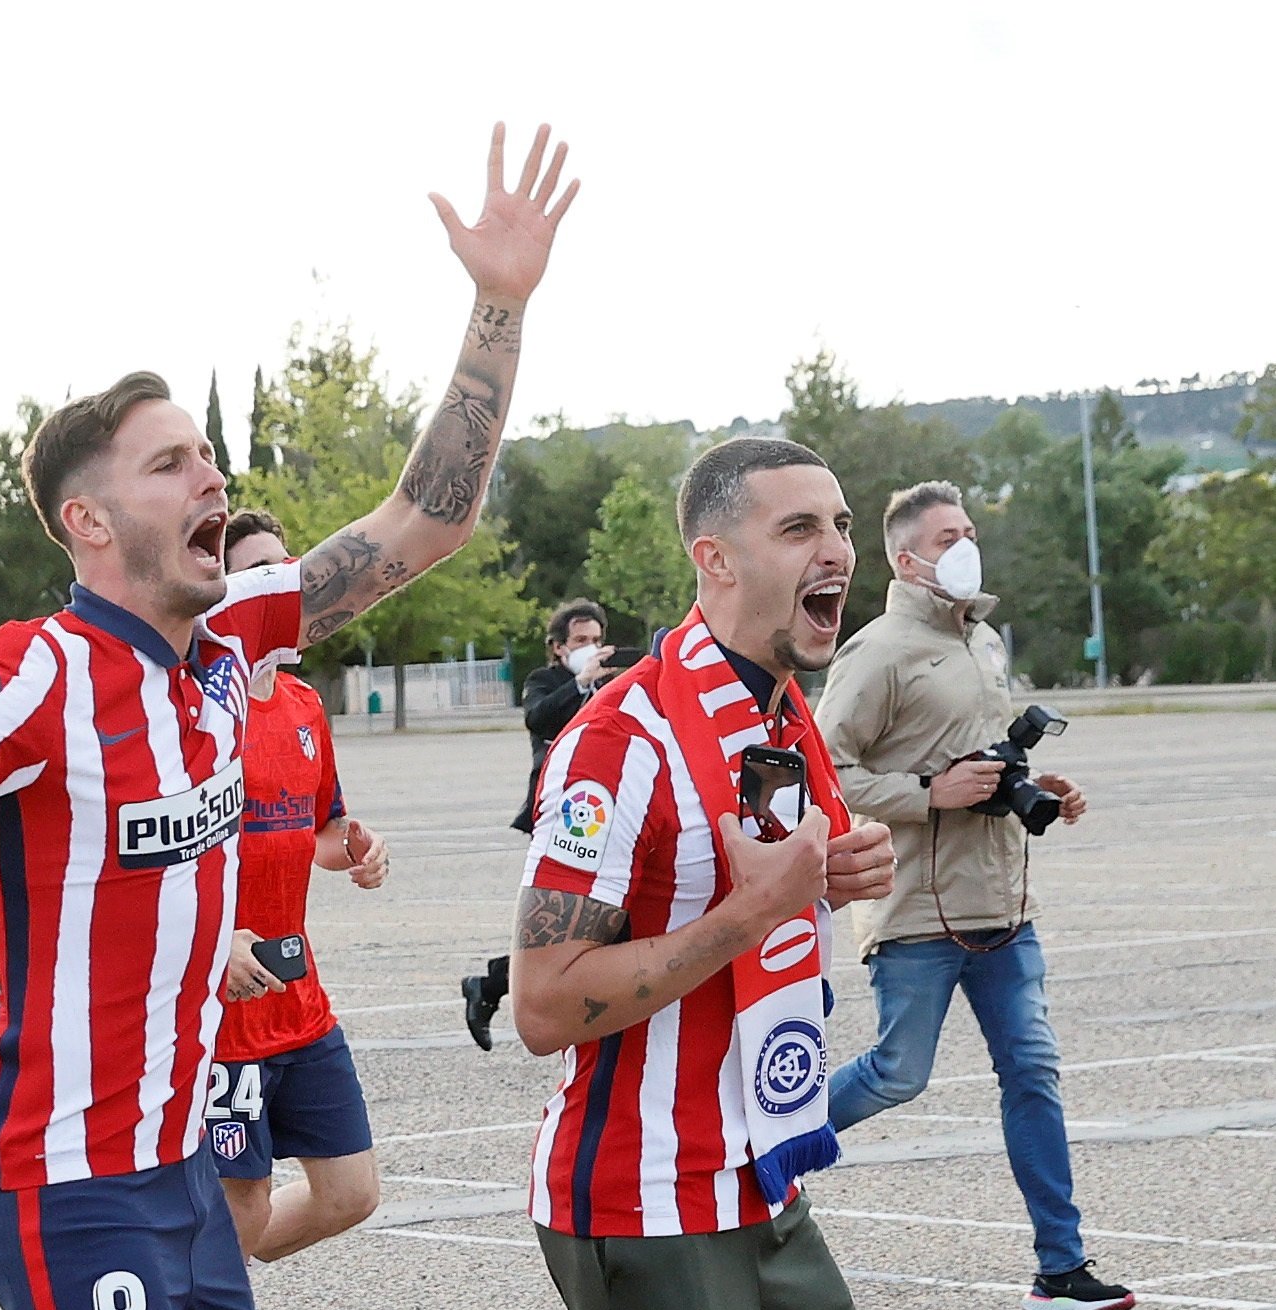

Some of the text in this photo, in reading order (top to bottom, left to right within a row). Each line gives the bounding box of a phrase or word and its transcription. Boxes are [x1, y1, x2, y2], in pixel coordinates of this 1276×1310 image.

[127, 777, 243, 850] Plus500
[179, 827, 230, 861] Trade Online
[553, 834, 598, 859] LaLiga
[204, 1063, 263, 1121] 24
